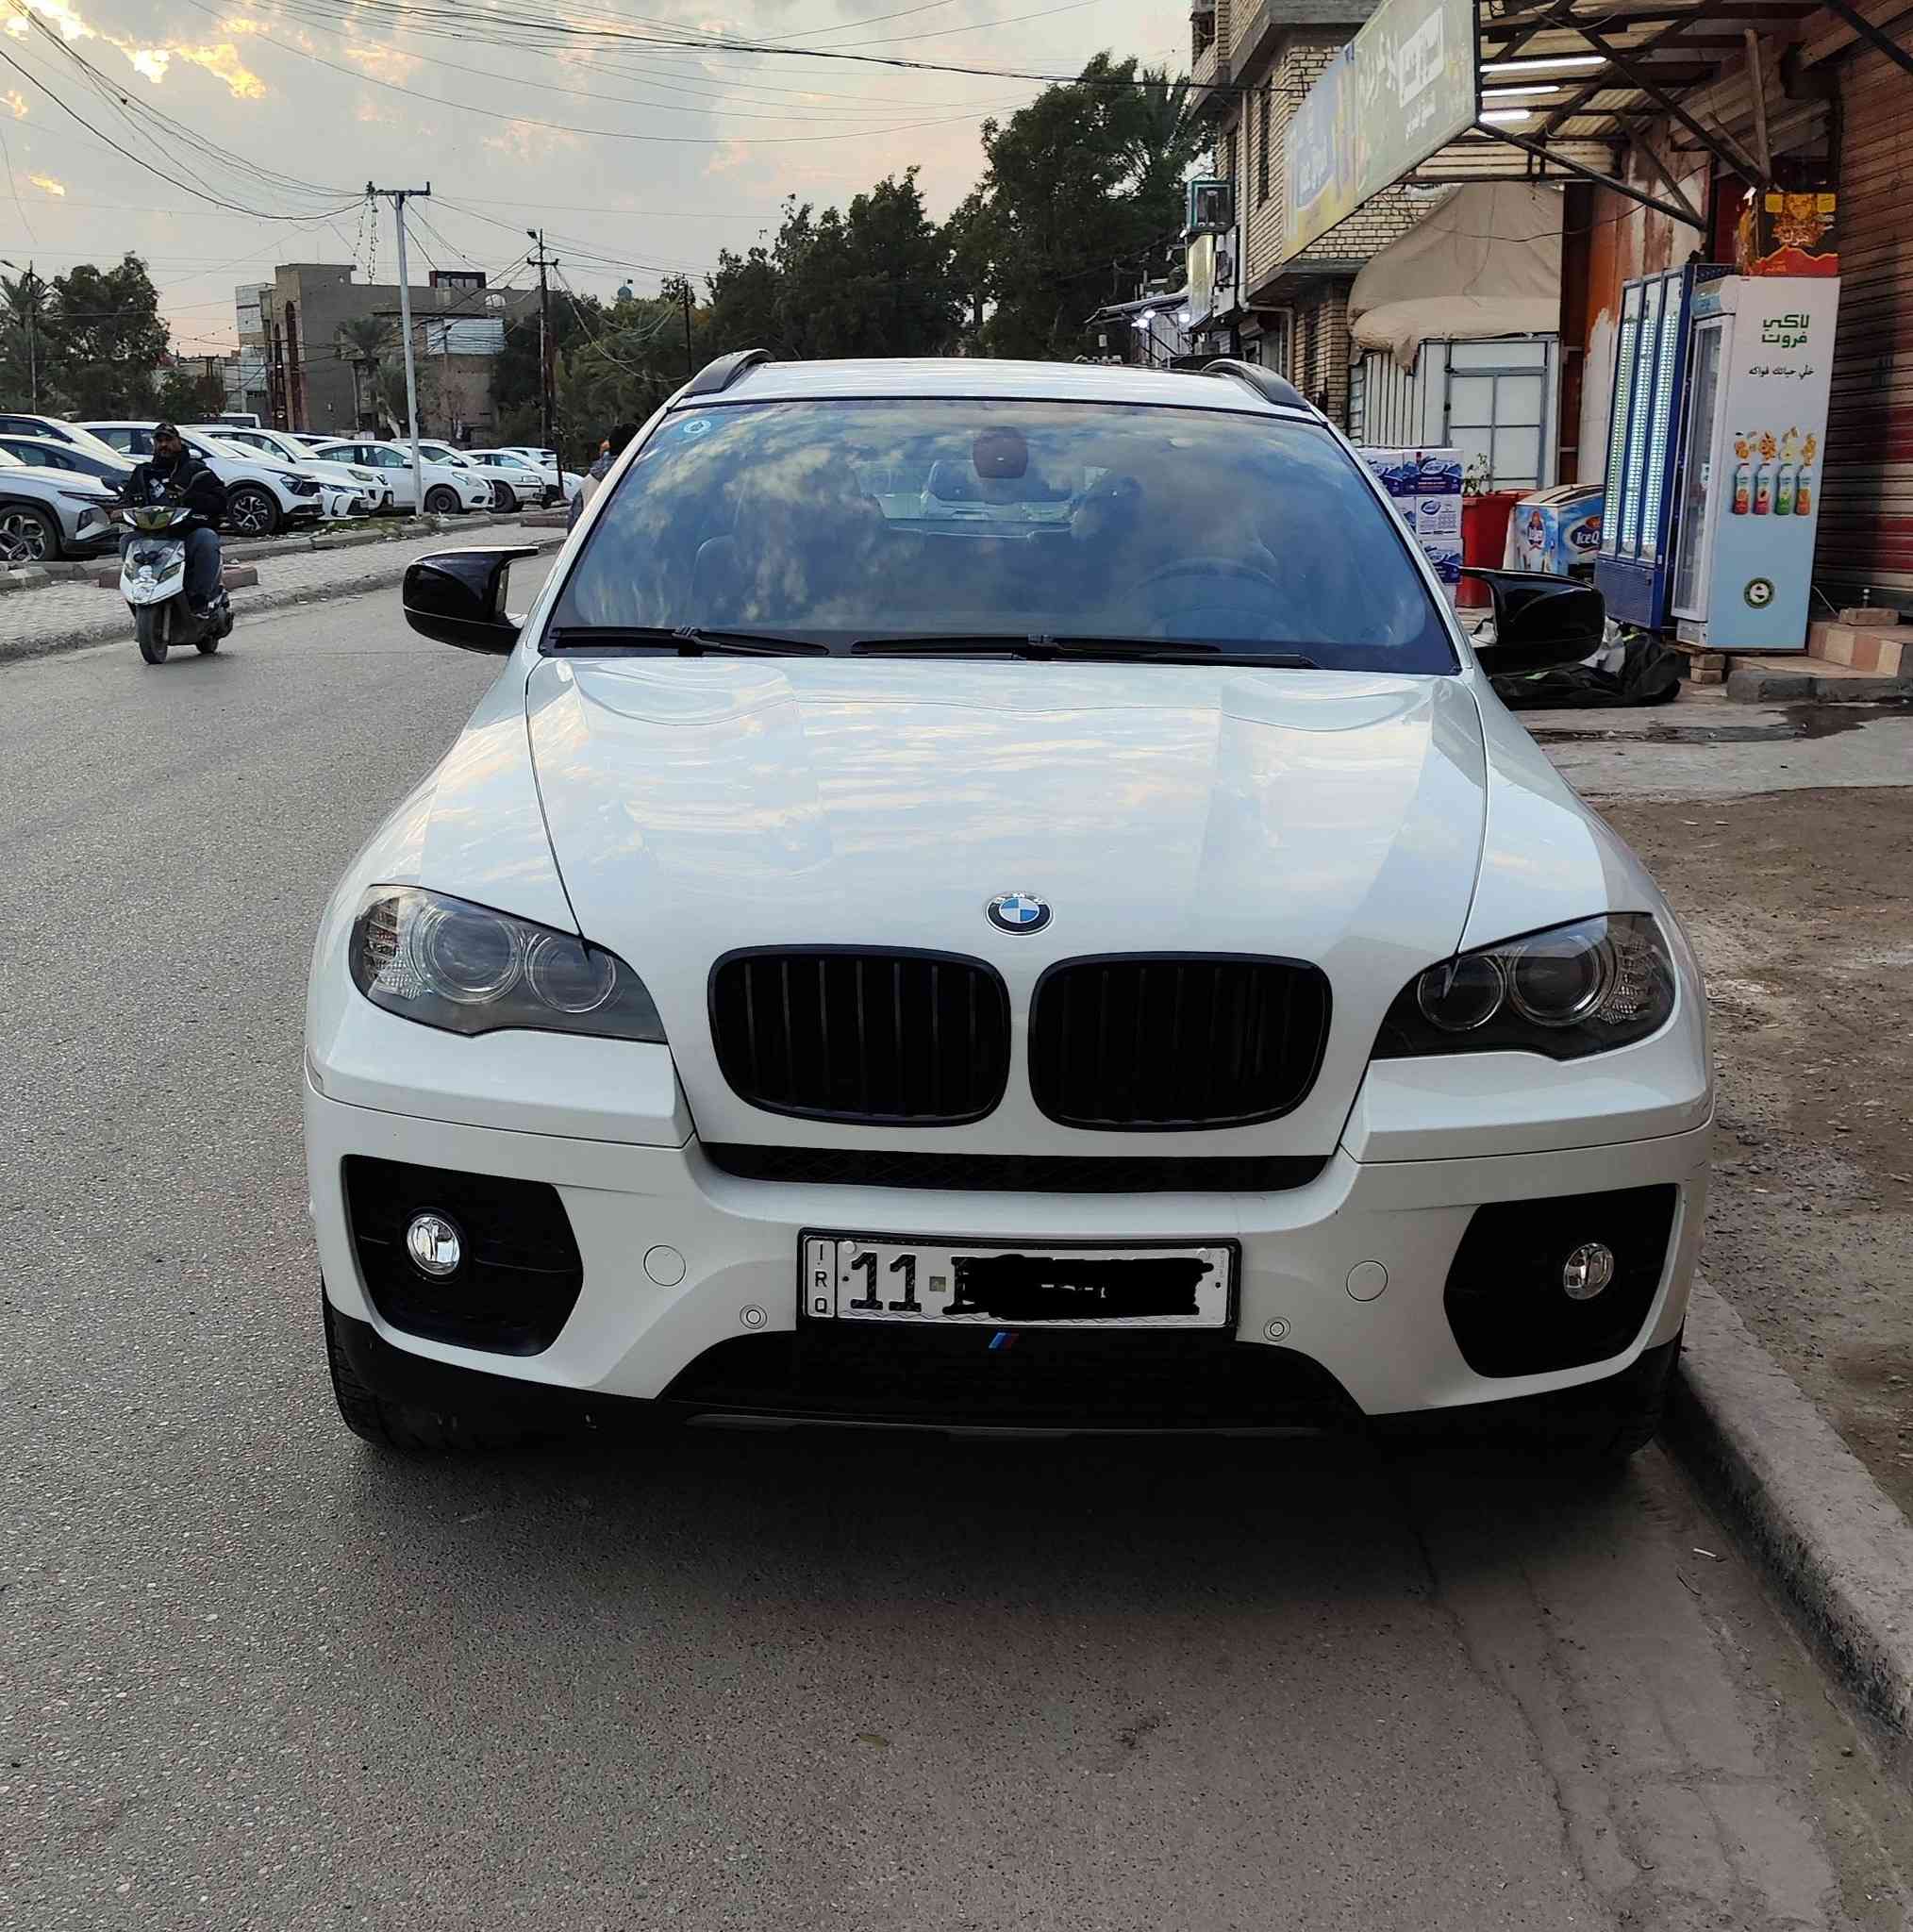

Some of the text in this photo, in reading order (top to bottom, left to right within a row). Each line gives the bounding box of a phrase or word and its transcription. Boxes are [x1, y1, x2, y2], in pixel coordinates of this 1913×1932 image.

[1762, 314, 1810, 331] لاكي
[1761, 331, 1807, 348] فروت
[1576, 530, 1601, 545] IceQ
[850, 1252, 922, 1313] 11
